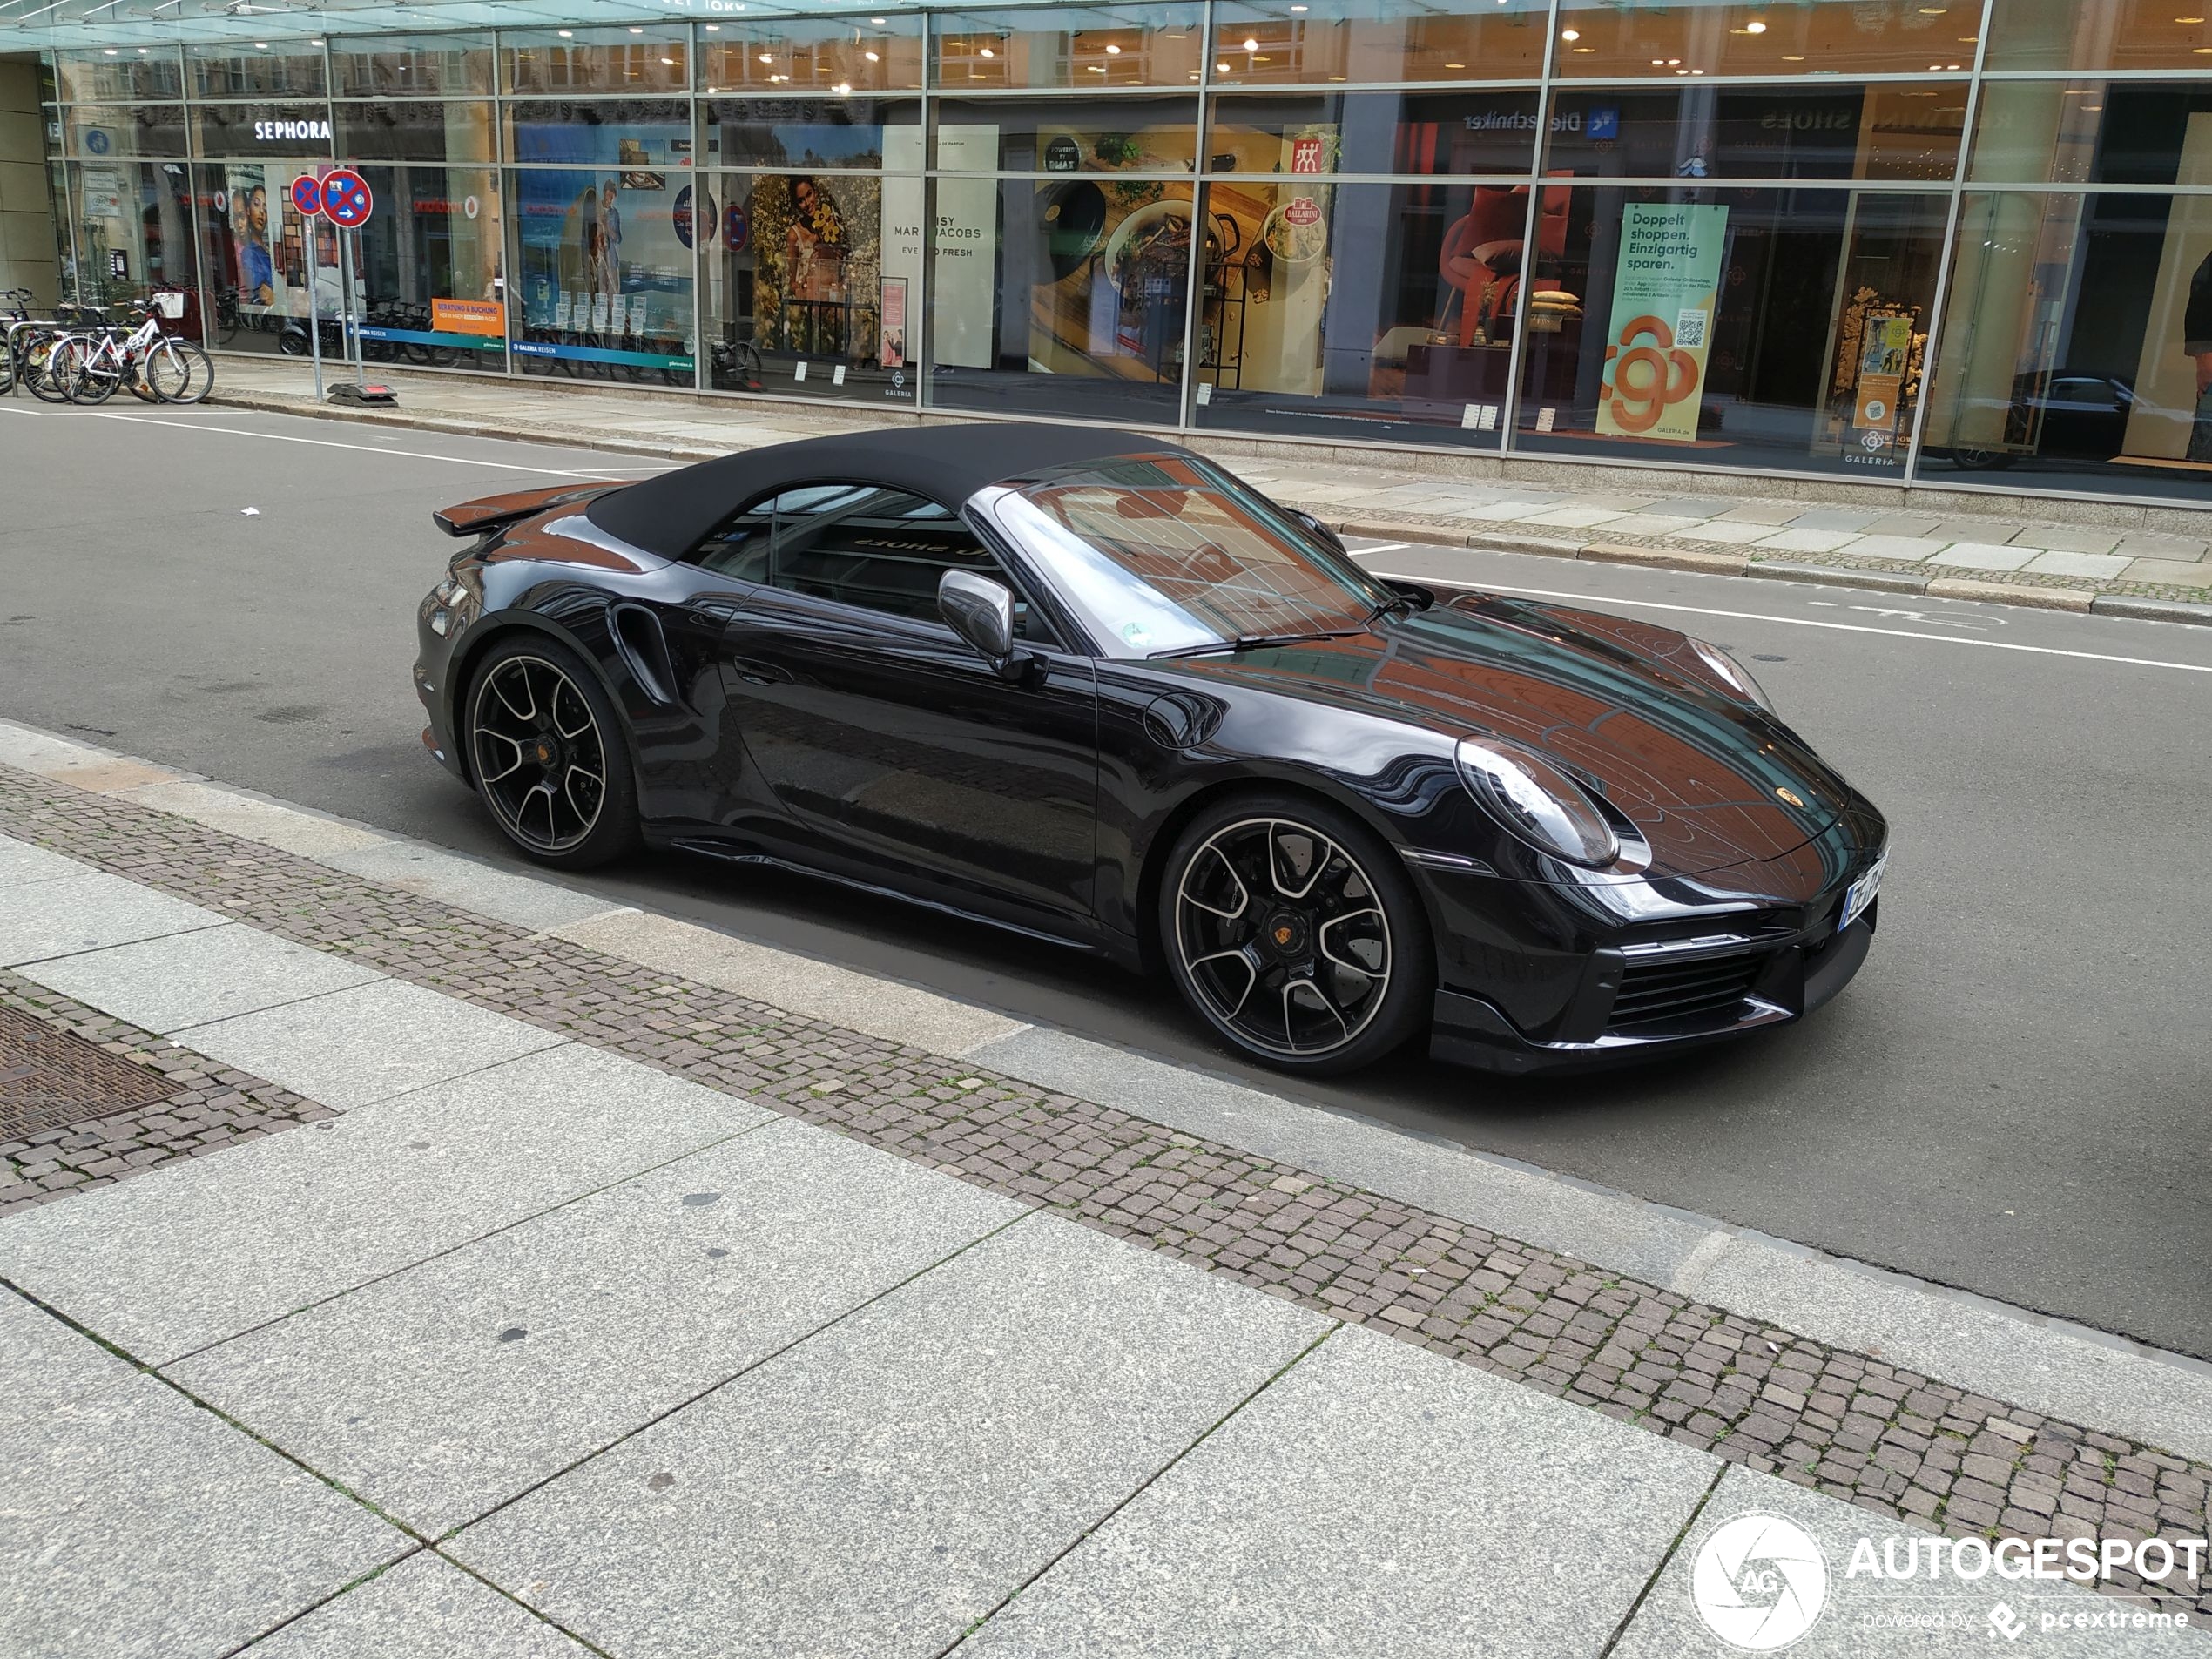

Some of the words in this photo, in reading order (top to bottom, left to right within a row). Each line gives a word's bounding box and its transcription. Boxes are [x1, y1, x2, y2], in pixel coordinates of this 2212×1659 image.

[254, 120, 330, 139] SEPHORA
[1287, 209, 1318, 218] BALLARINI
[1632, 212, 1685, 227] Doppelt
[894, 226, 920, 237] MAR
[1630, 228, 1690, 242] shoppen.
[942, 248, 973, 257] FRESH
[1629, 242, 1698, 259] Einzigartig
[1626, 260, 1675, 271] sparen.
[437, 302, 466, 312] BERATUNG
[470, 306, 498, 314] BUCHUNG
[519, 343, 538, 352] GALERIA
[537, 344, 556, 354] REISEN
[885, 389, 912, 398] GALERIA
[1657, 427, 1690, 435] GALERIA.de
[1844, 455, 1894, 467] GALERIA
